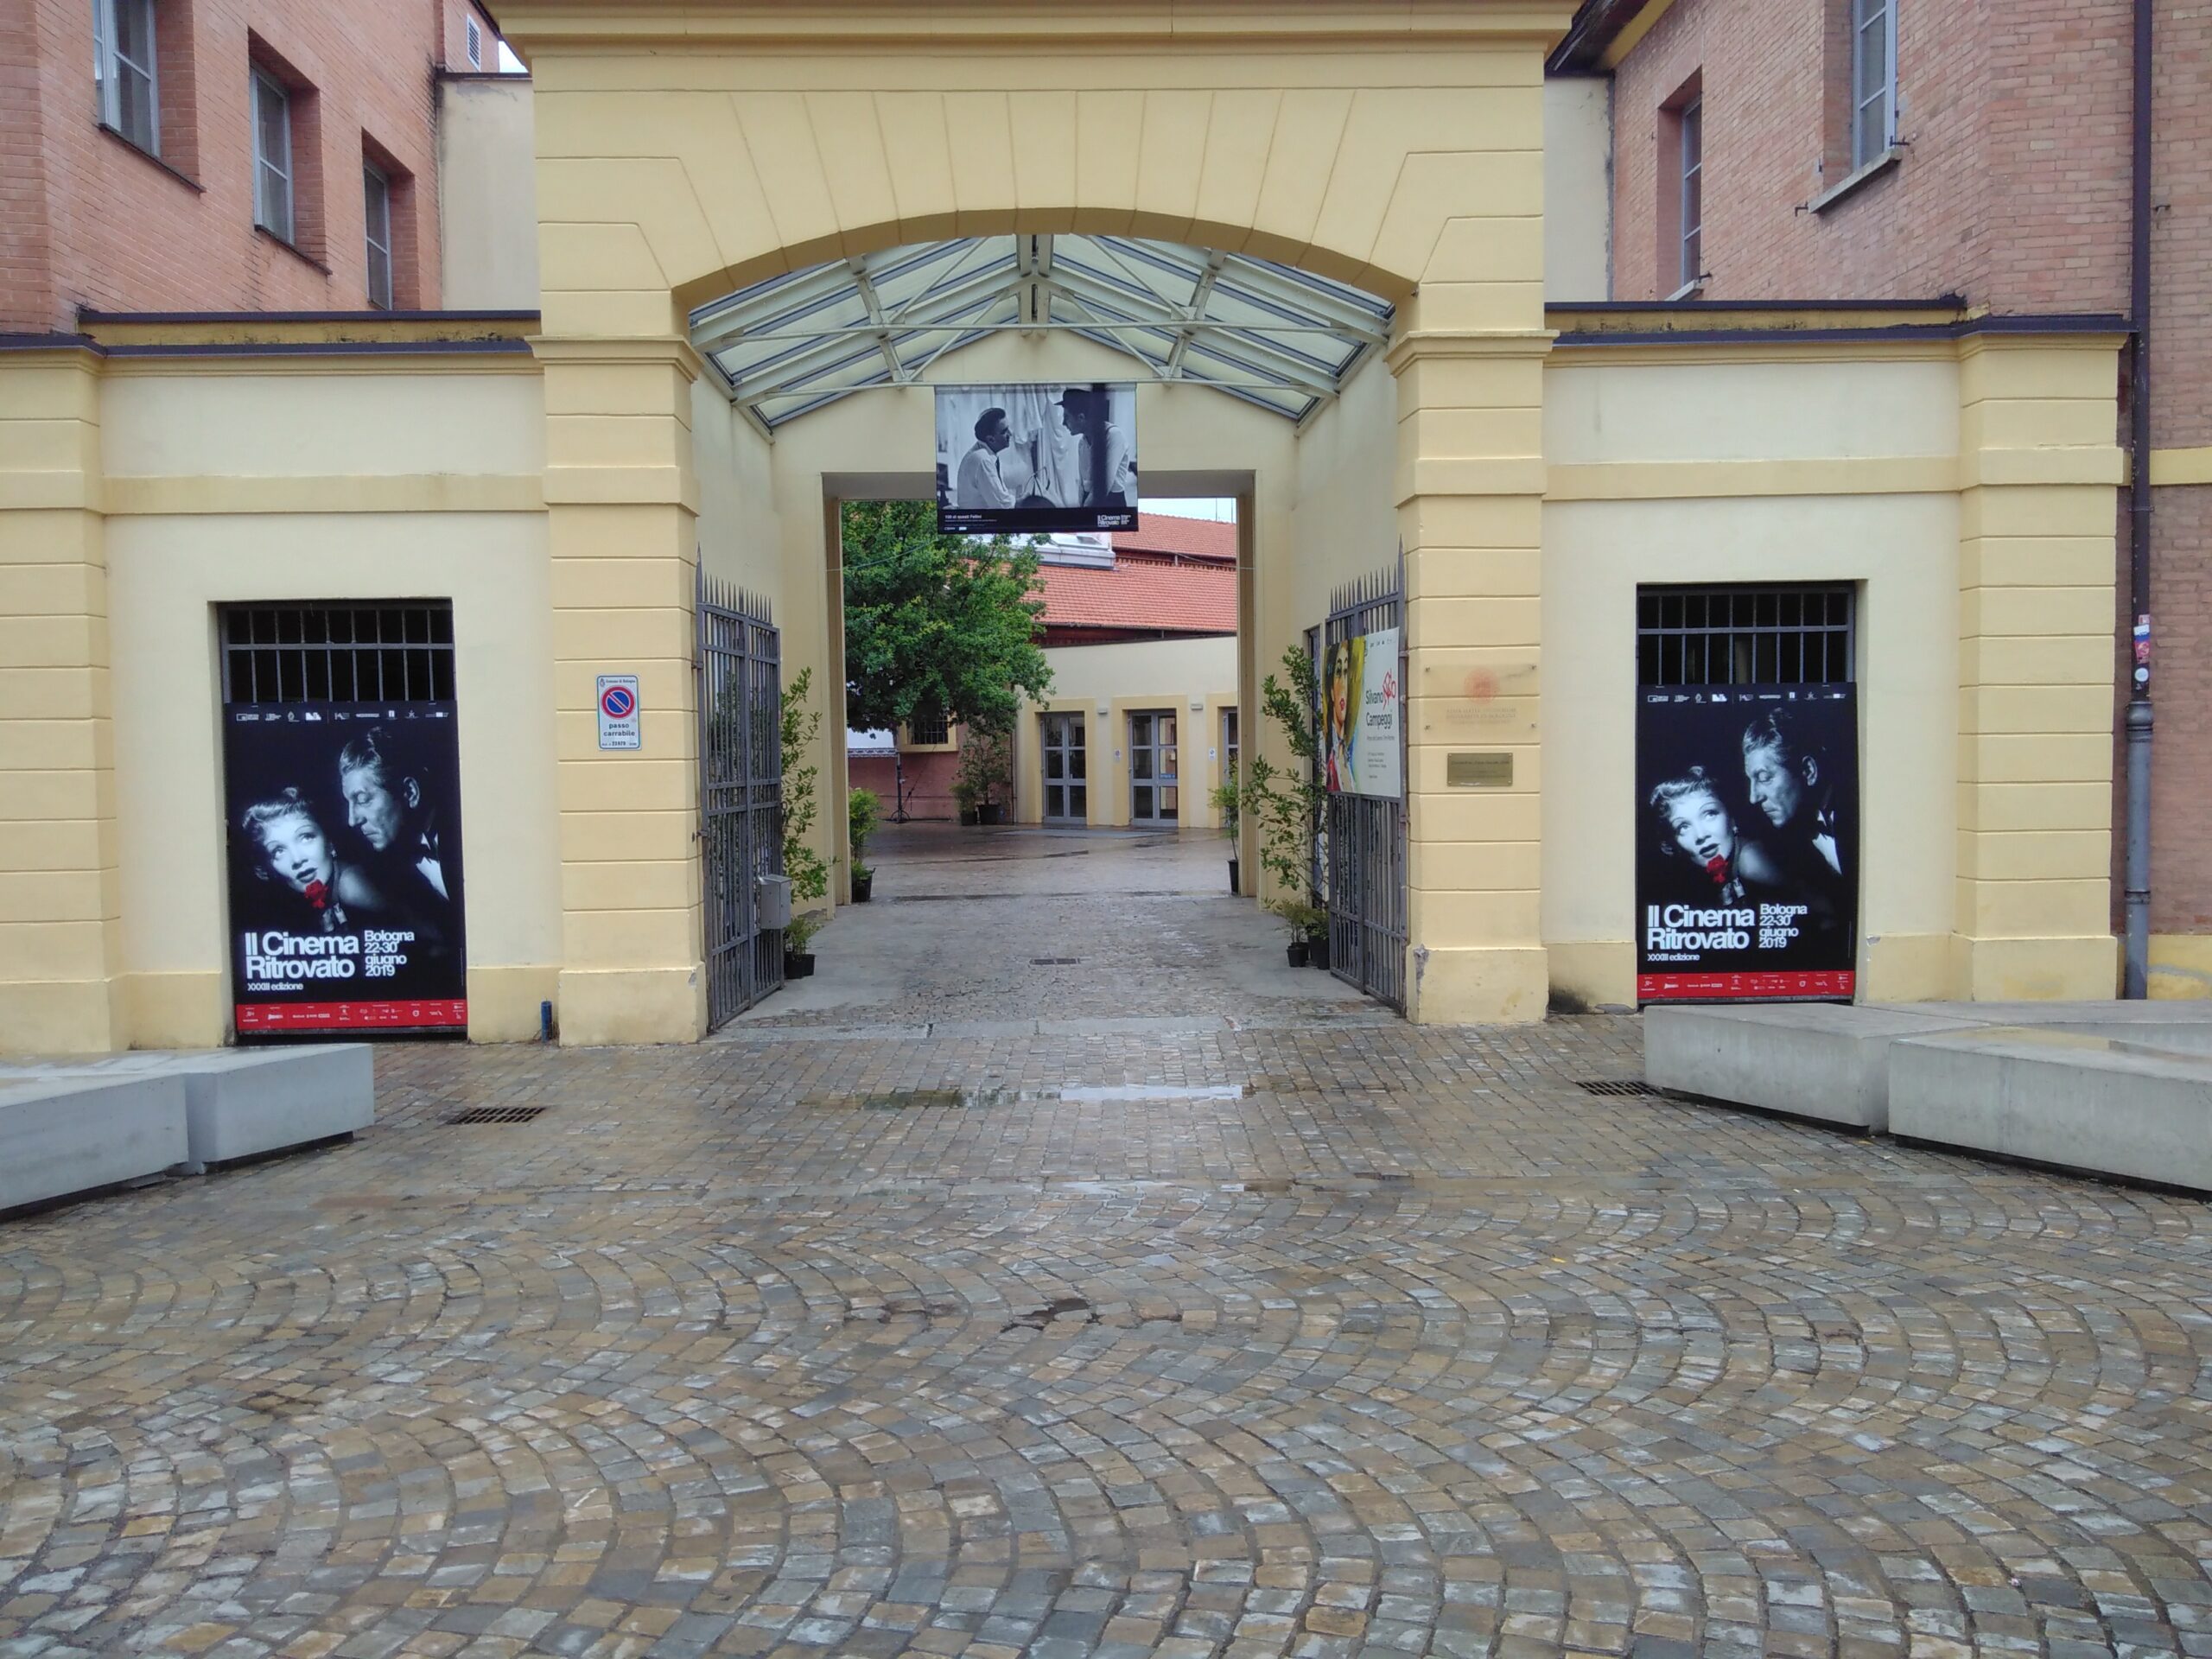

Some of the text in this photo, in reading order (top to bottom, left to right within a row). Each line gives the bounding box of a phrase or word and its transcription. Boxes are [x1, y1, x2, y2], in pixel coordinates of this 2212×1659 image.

[1365, 689, 1383, 705] Silvano
[1366, 710, 1393, 729] Campeggi
[1647, 904, 1755, 928] Il Cinema
[1759, 903, 1808, 917] Bologna
[1759, 915, 1791, 926] 22-30
[364, 930, 415, 944] Bologna
[1647, 927, 1750, 950] Ritrovato
[1758, 926, 1799, 938] giugno
[245, 931, 359, 956] Il Cinema
[364, 942, 397, 953] 22-30
[1758, 938, 1787, 949] 2019
[365, 953, 407, 966] giugno
[245, 955, 356, 979] Ritrovato
[365, 965, 395, 976] 2019
[270, 982, 303, 991] edizione
